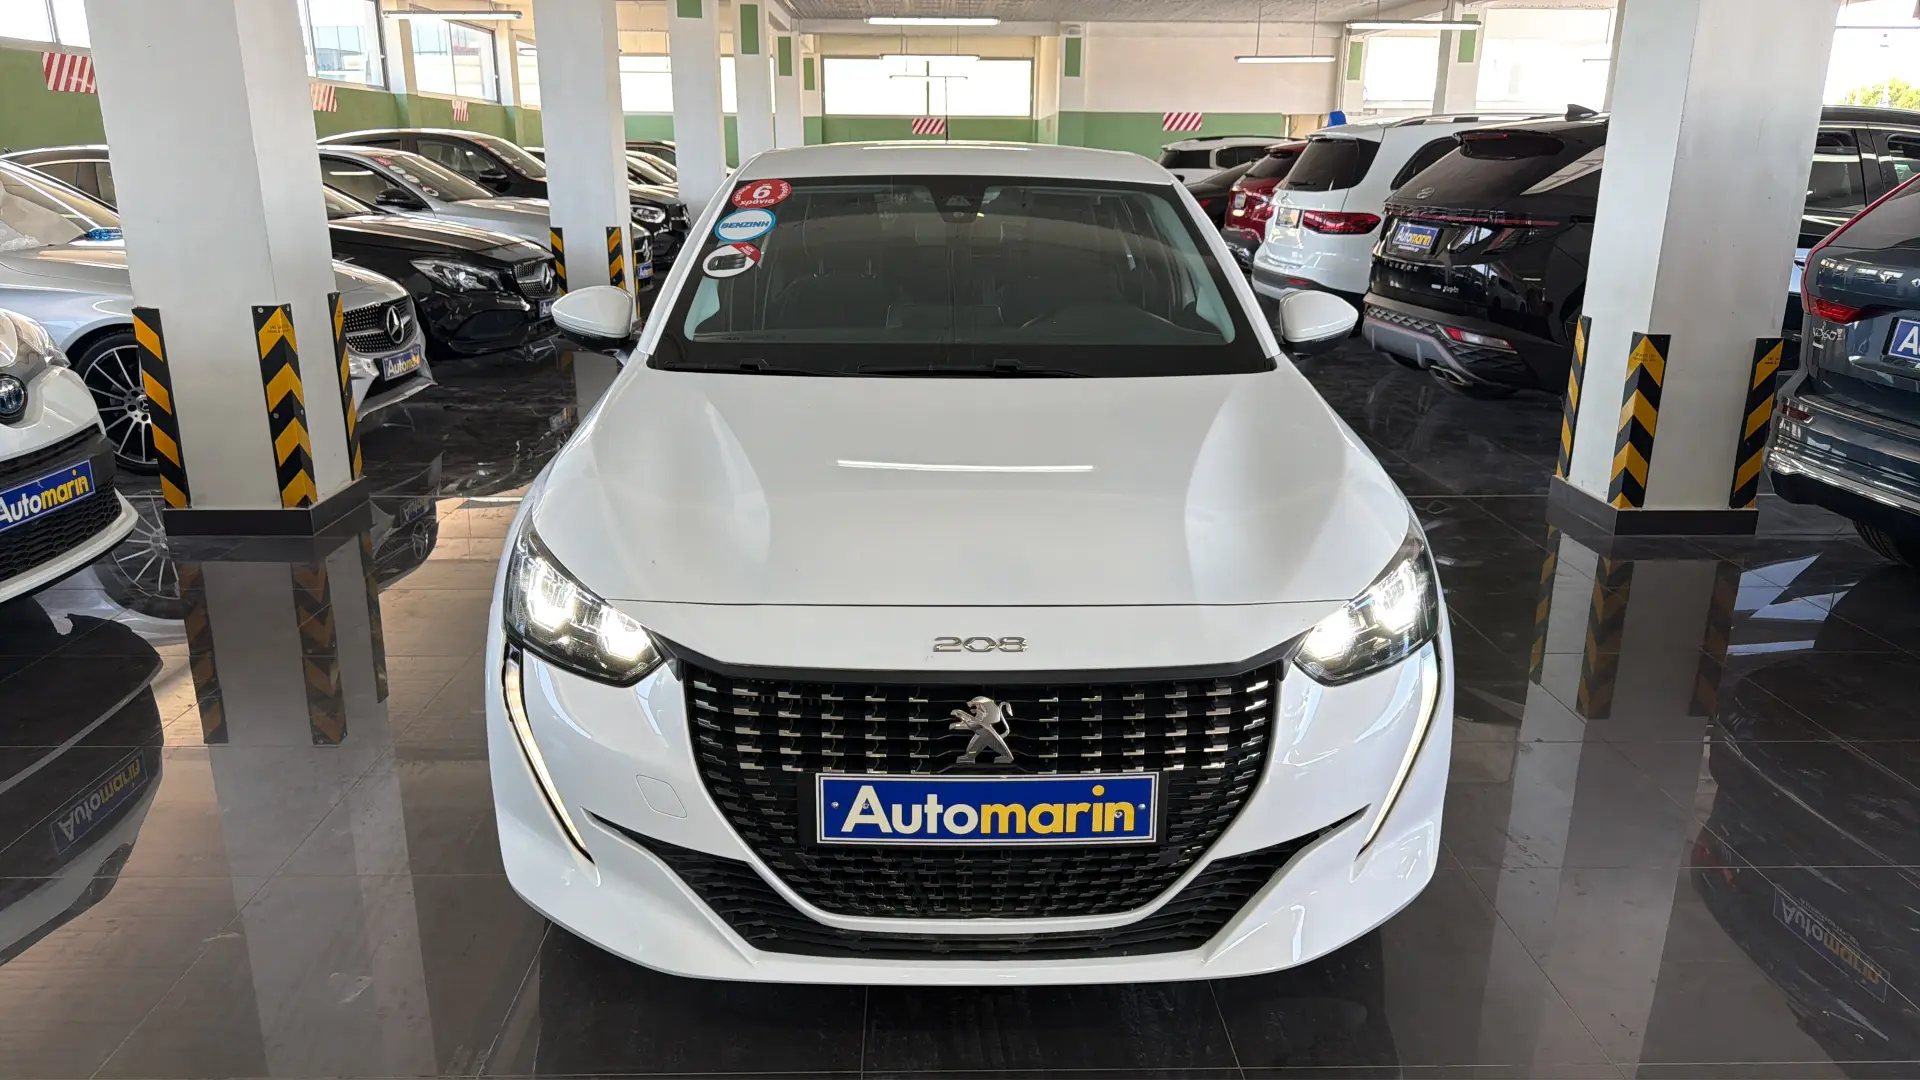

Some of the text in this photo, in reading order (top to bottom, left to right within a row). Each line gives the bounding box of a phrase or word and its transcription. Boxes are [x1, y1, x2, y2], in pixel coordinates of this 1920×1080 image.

[752, 185, 773, 199] 6
[1395, 226, 1432, 246] Automarin
[0, 469, 90, 523] Automarin
[932, 636, 1029, 652] 208
[841, 784, 1135, 834] Automarin
